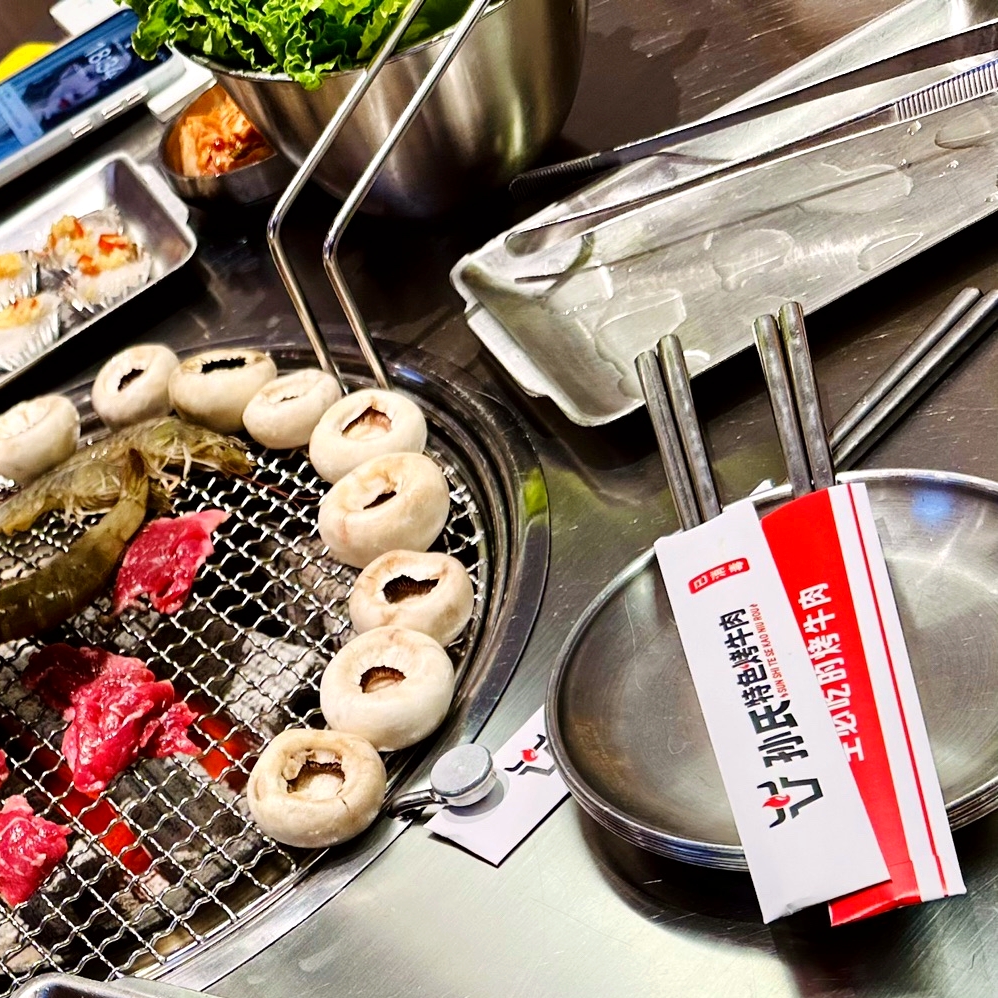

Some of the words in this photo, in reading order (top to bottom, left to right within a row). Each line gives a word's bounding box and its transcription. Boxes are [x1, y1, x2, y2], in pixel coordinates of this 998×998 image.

[750, 607, 762, 621] ROU
[755, 621, 766, 633] NIU
[764, 648, 774, 657] SE
[767, 657, 777, 667] TE
[771, 667, 782, 679] SHI
[775, 679, 787, 693] SUN
